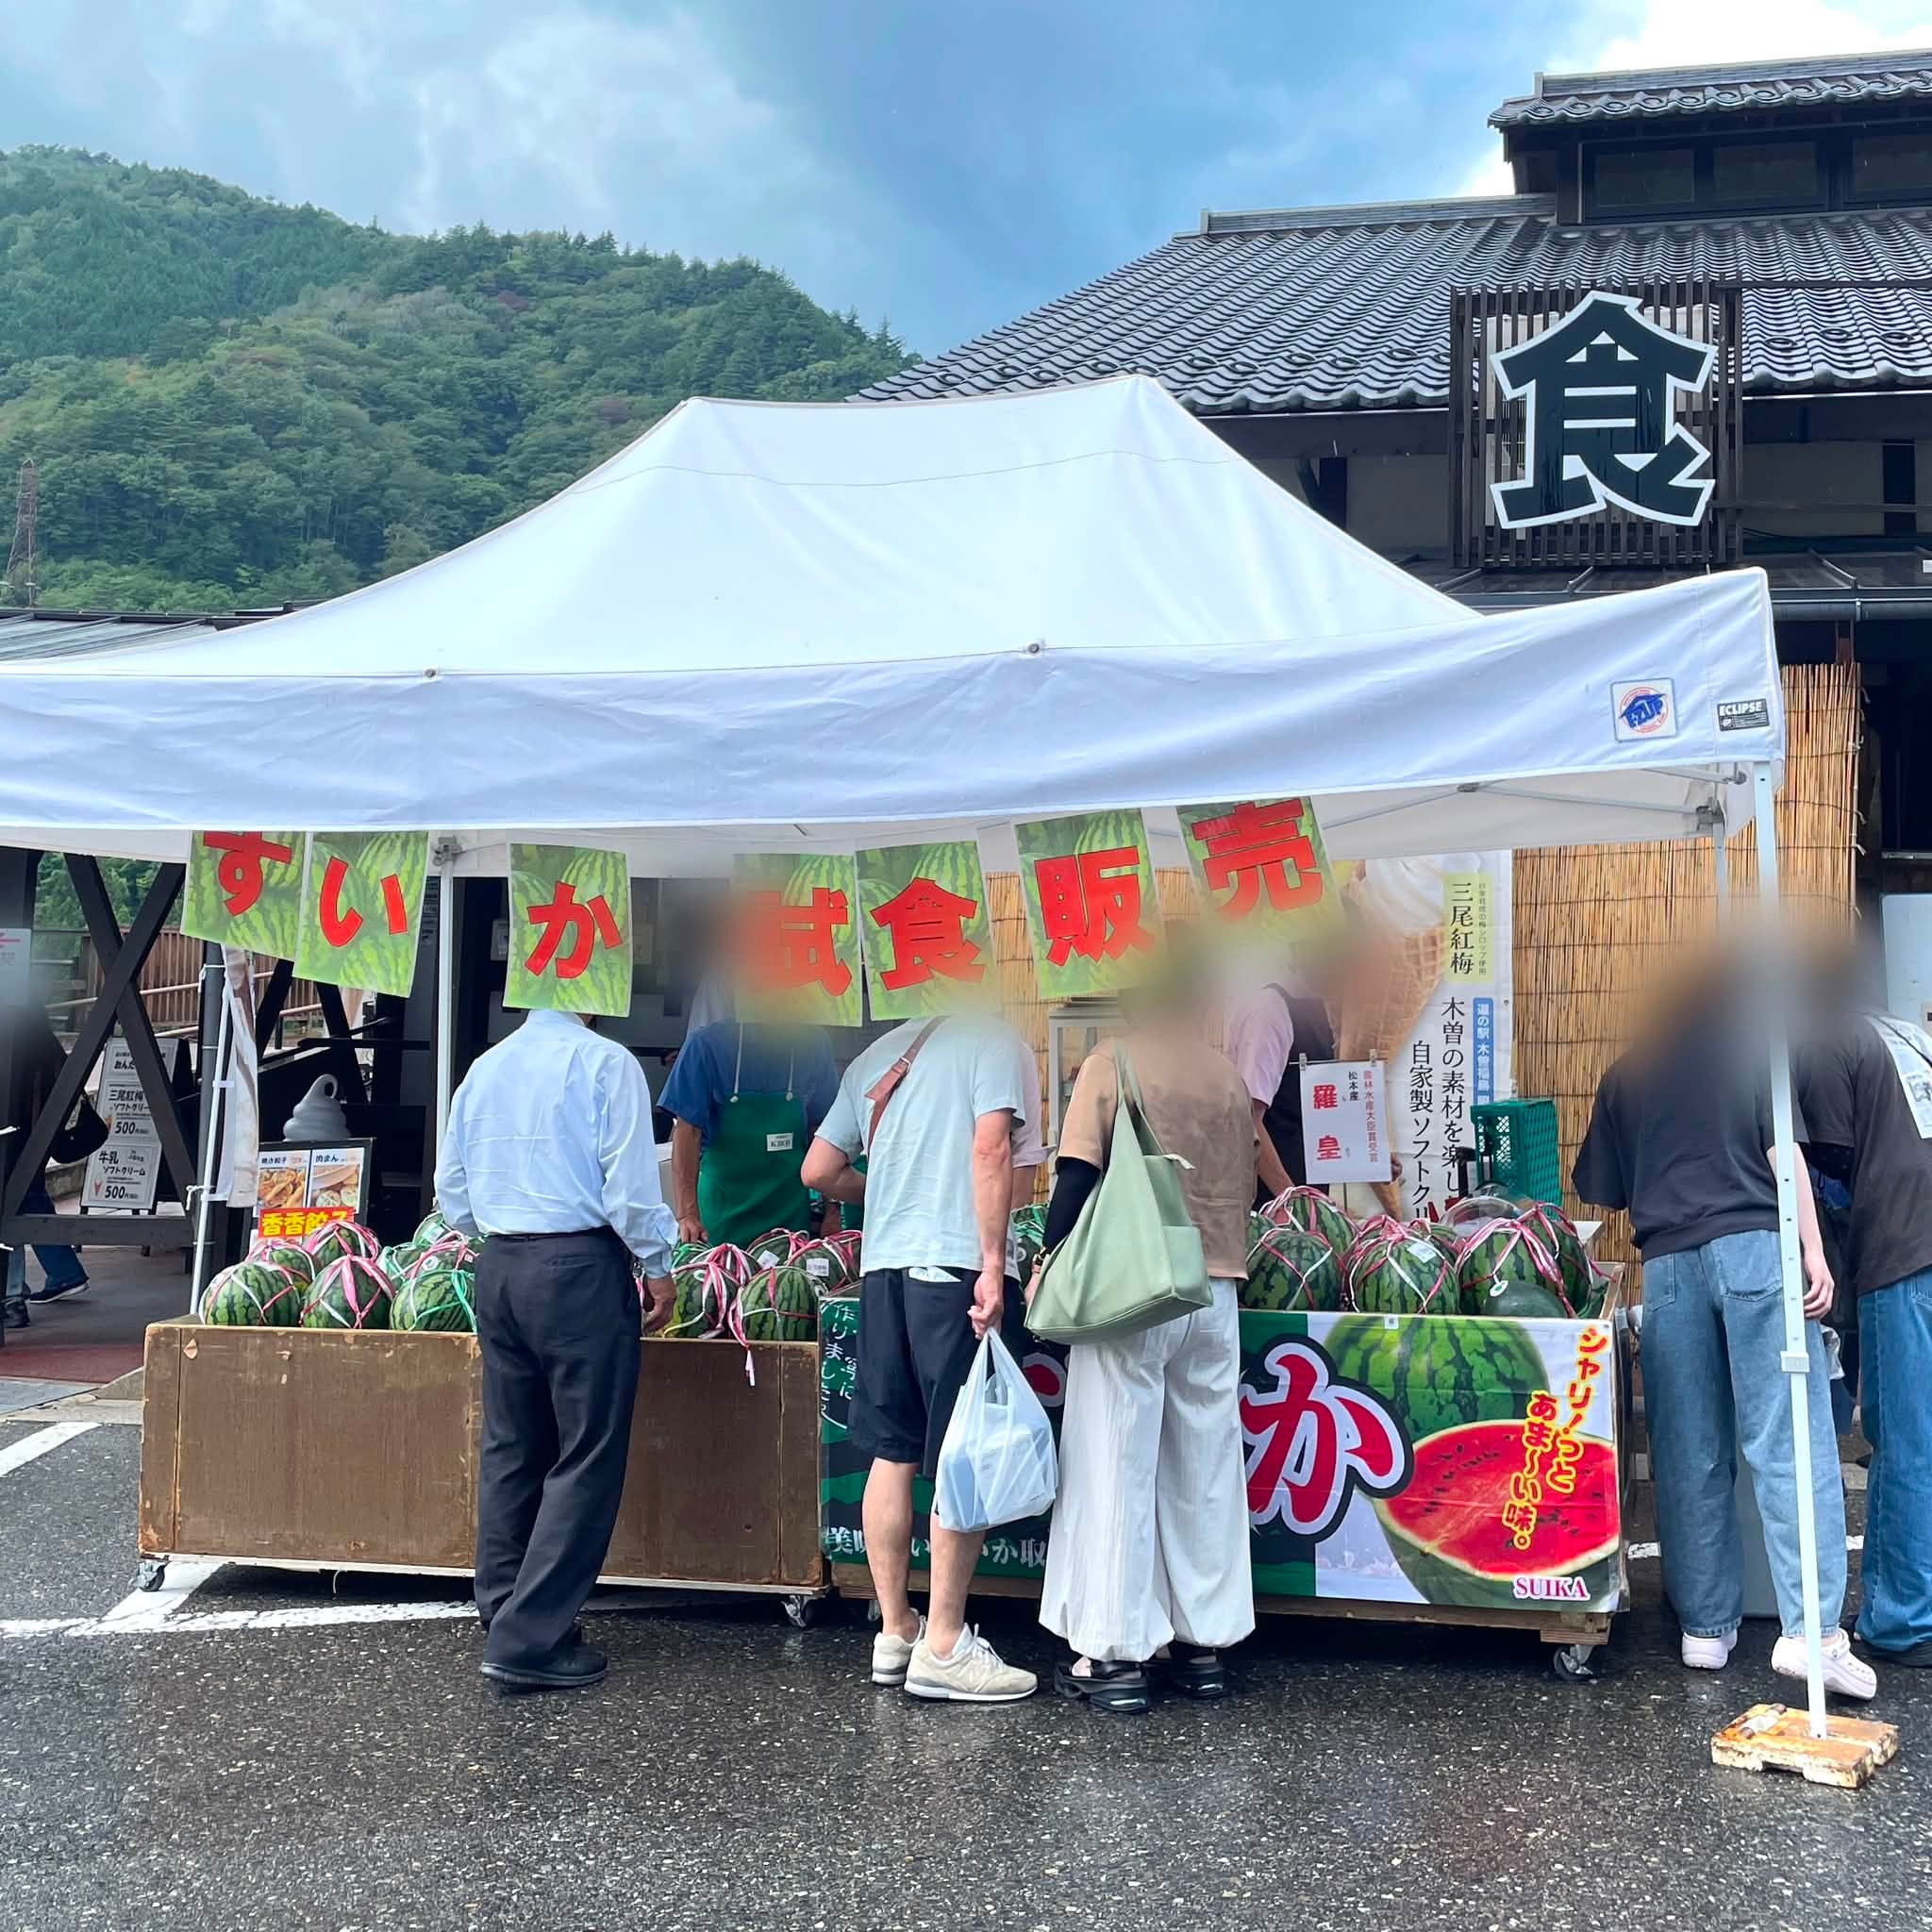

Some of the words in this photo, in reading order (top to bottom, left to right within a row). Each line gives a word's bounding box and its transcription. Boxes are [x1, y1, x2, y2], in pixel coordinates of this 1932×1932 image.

[1489, 290, 1717, 530] 食
[1720, 701, 1762, 717] ECLIPSE
[203, 831, 292, 916] す
[319, 856, 408, 947] い
[525, 880, 625, 979] か
[869, 876, 987, 992] 食
[1034, 845, 1153, 967] 販
[1191, 798, 1324, 924] 売
[1450, 882, 1474, 974] 三尾紅梅
[1348, 1071, 1359, 1102] 松本産
[115, 1122, 136, 1135] 500
[1313, 1084, 1342, 1161] 羅皇
[98, 1151, 120, 1165] 牛乳
[315, 1154, 340, 1163] 肉まん
[103, 1166, 146, 1176] ソフトクリーム
[105, 1186, 125, 1199] 500
[1514, 1576, 1591, 1600] SUIKA
